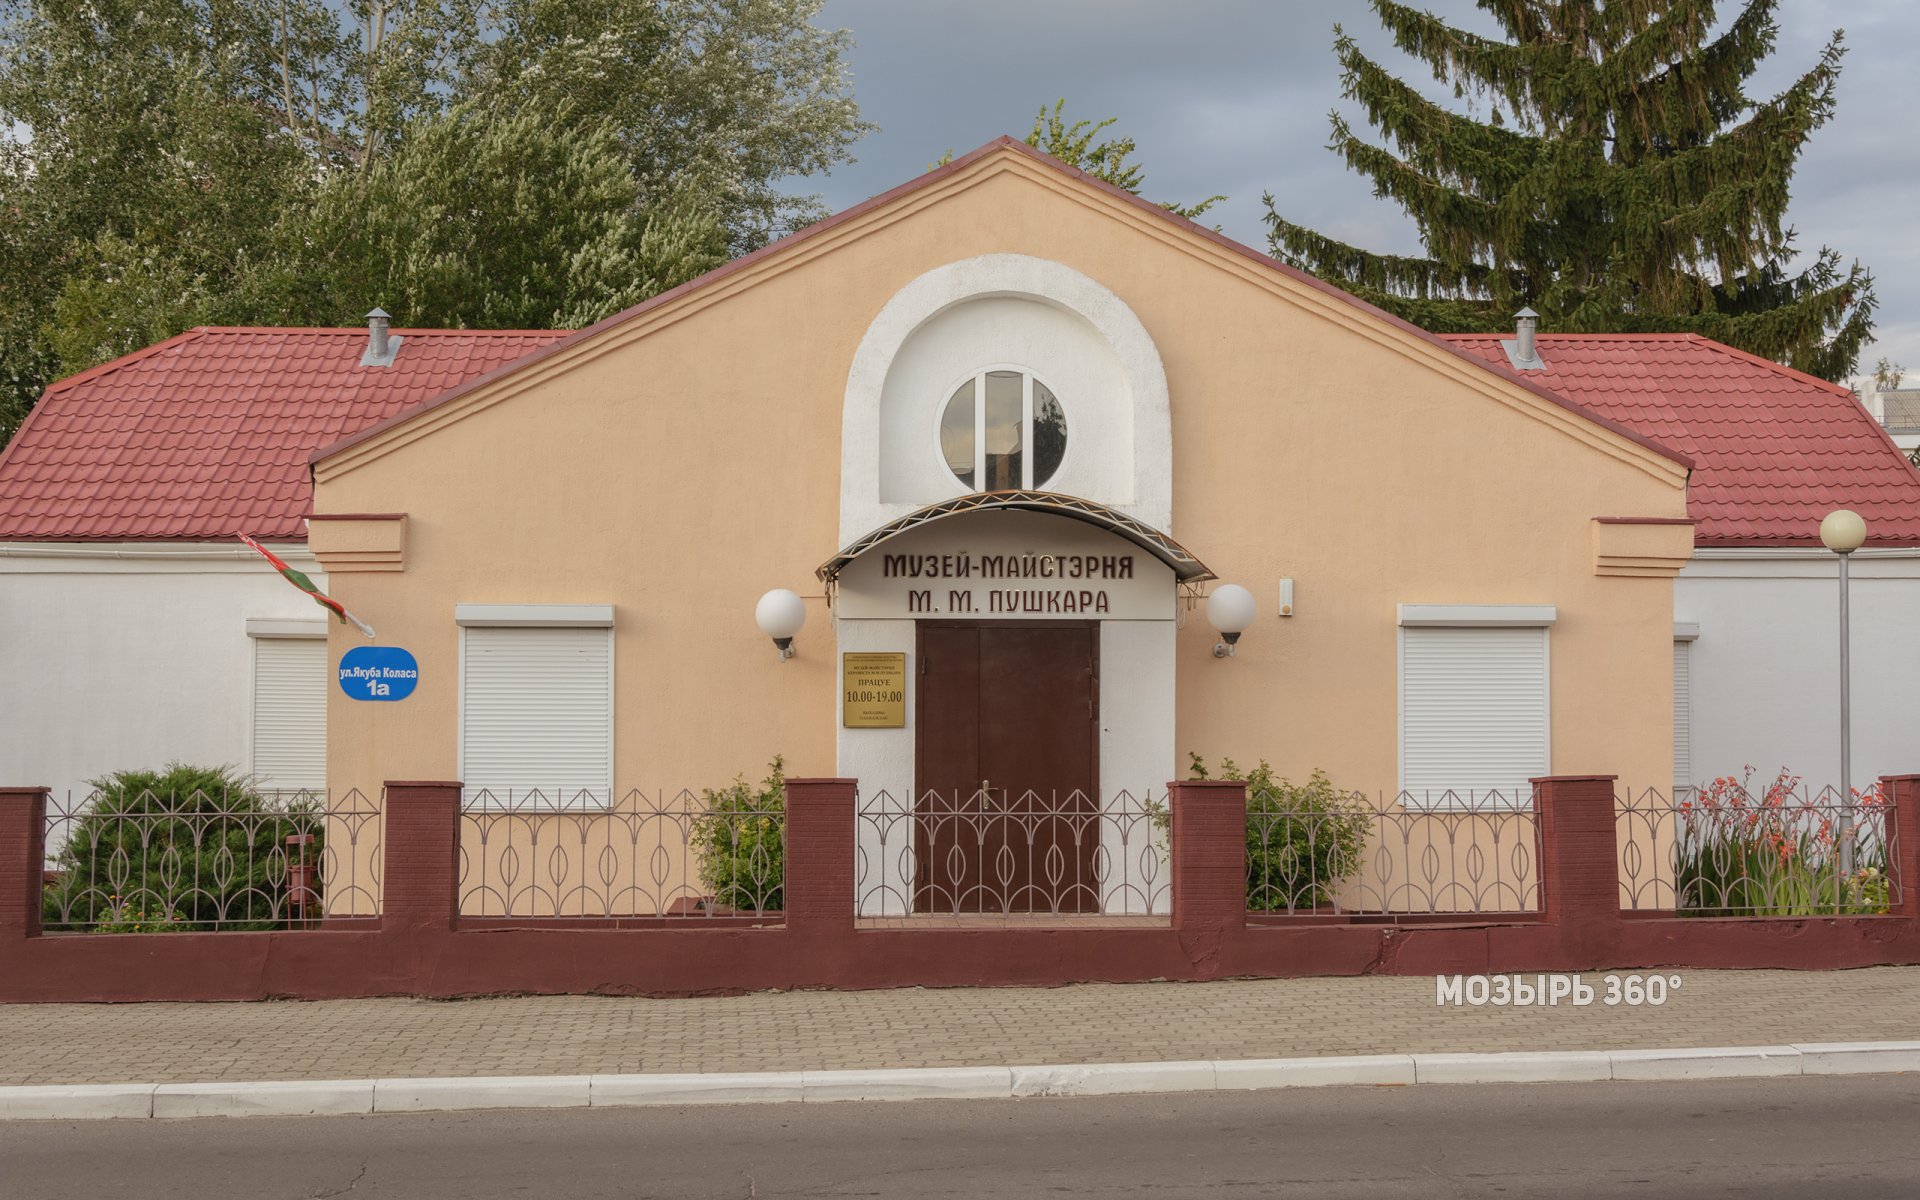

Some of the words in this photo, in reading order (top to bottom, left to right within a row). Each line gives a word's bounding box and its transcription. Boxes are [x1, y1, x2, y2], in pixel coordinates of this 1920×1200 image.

[883, 551, 1134, 580] МУЗЕЙ-МАЙСТЭРНЯ
[989, 589, 1110, 614] ПУШКАРА
[383, 667, 417, 679] Коласа
[366, 679, 390, 696] 1а
[858, 679, 892, 687] ПРАЦУЕ
[847, 690, 902, 703] 10.00-19.00
